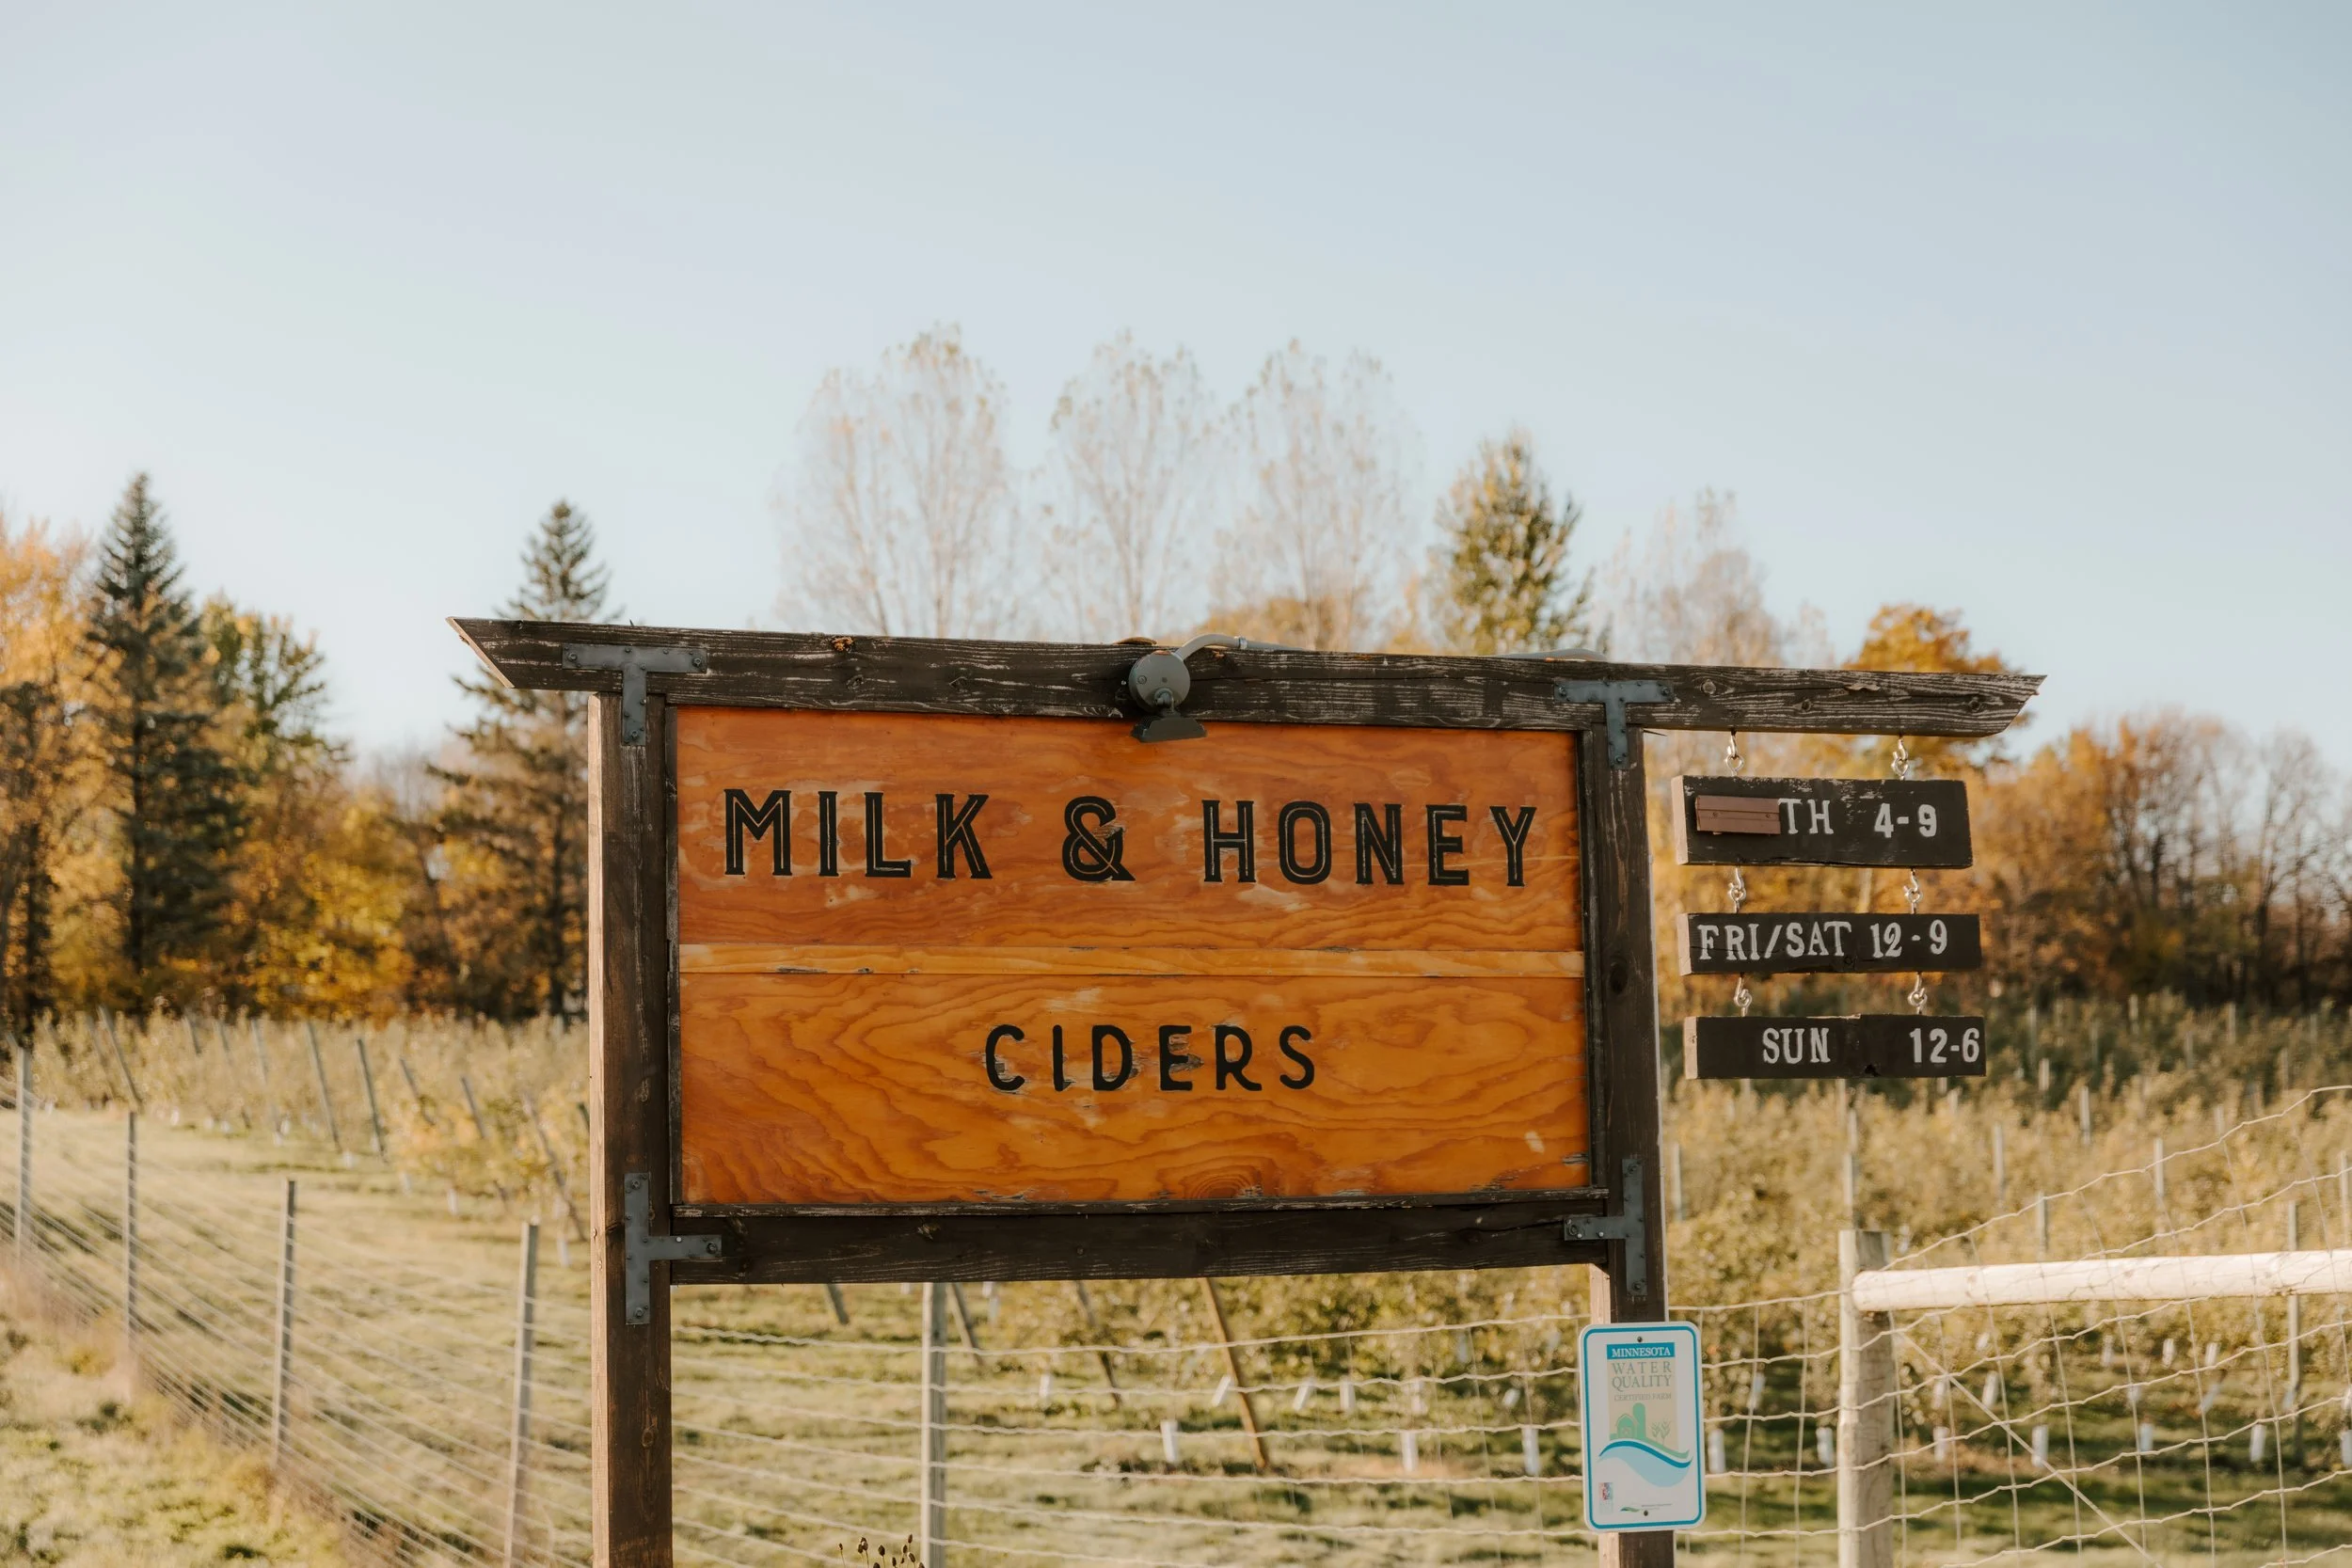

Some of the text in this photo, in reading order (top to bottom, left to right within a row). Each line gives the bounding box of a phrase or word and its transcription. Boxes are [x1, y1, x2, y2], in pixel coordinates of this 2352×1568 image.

[1778, 798, 1834, 835] TH
[724, 788, 1536, 888] MILK & HONEY
[1696, 921, 1851, 960] FRI/SAT
[984, 1024, 1314, 1092] CIDERS
[1762, 1026, 1980, 1064] SUN 12-6
[1612, 1347, 1671, 1357] MINNESOTA
[1612, 1361, 1672, 1374] WATER
[1612, 1375, 1672, 1391] QUALITY
